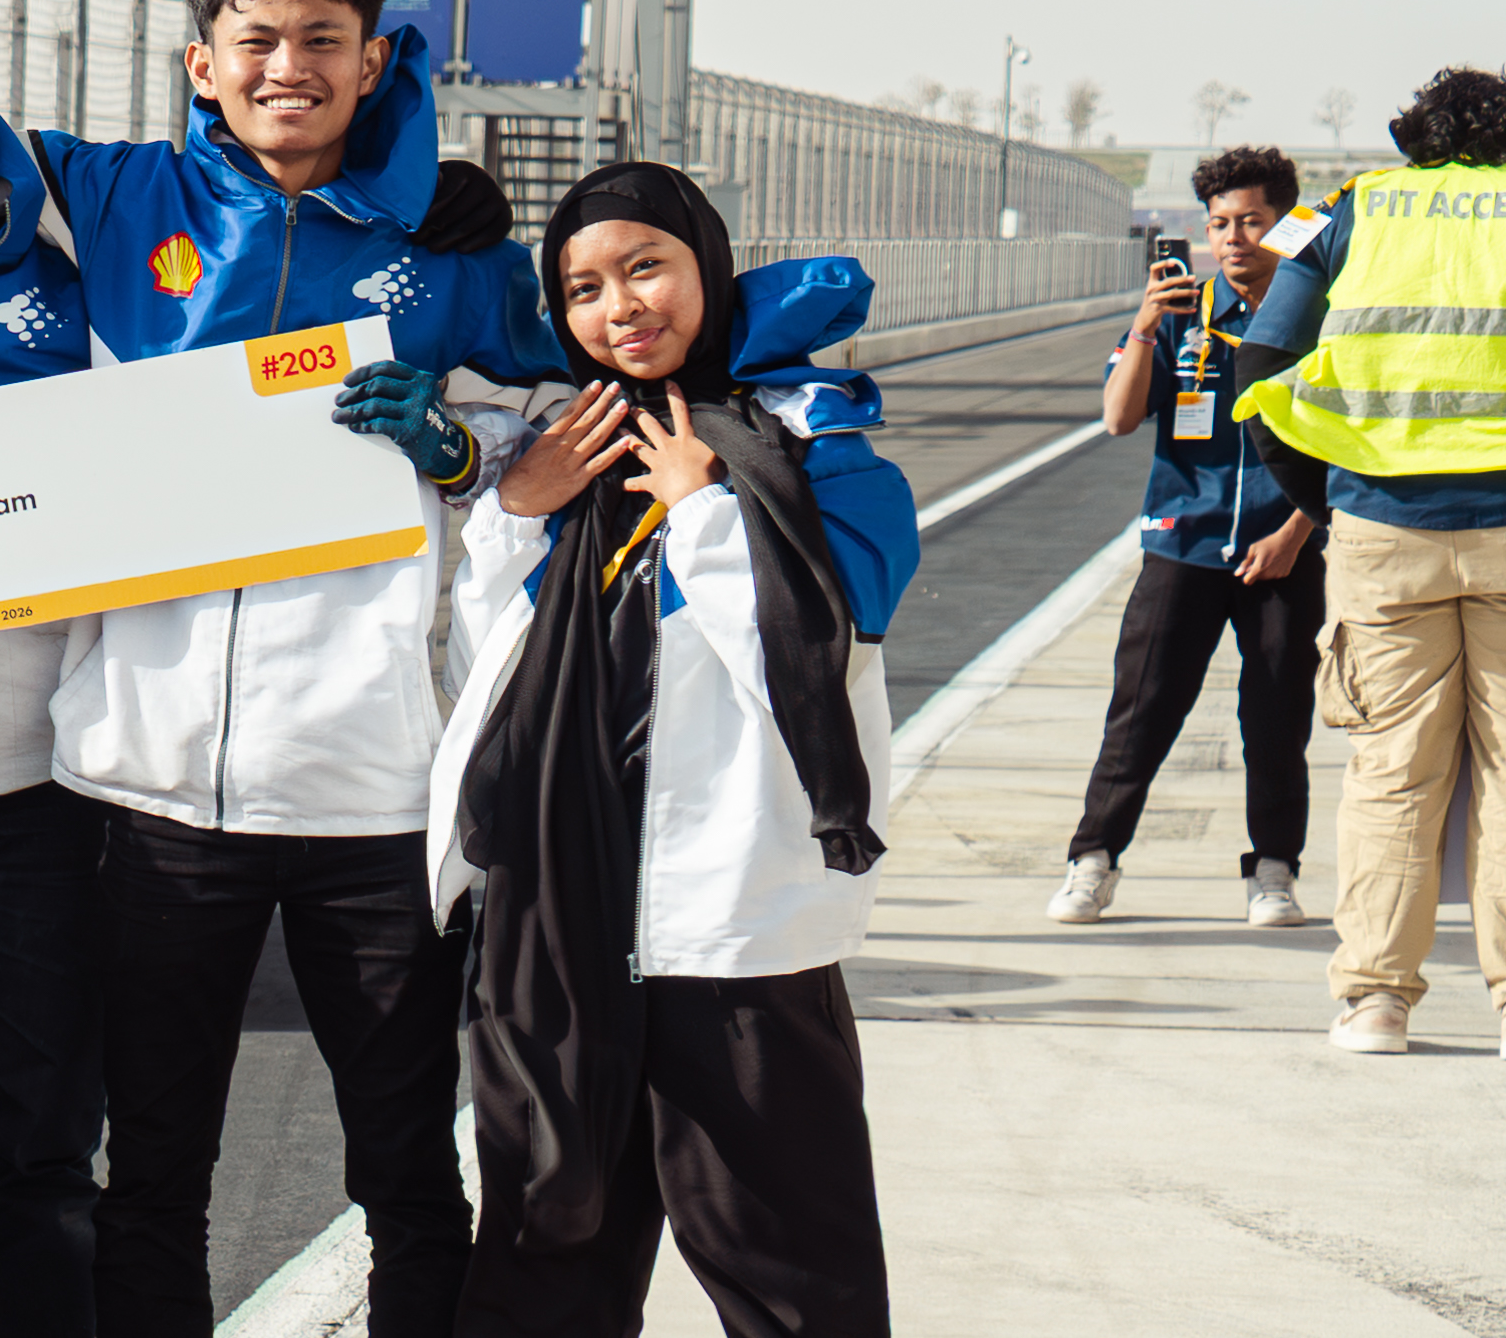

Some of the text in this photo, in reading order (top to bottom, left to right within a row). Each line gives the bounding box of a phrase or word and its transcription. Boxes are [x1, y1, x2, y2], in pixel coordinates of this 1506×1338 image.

[1367, 190, 1418, 218] PIT
[260, 344, 338, 381] #203
[1, 604, 34, 624] 2026
